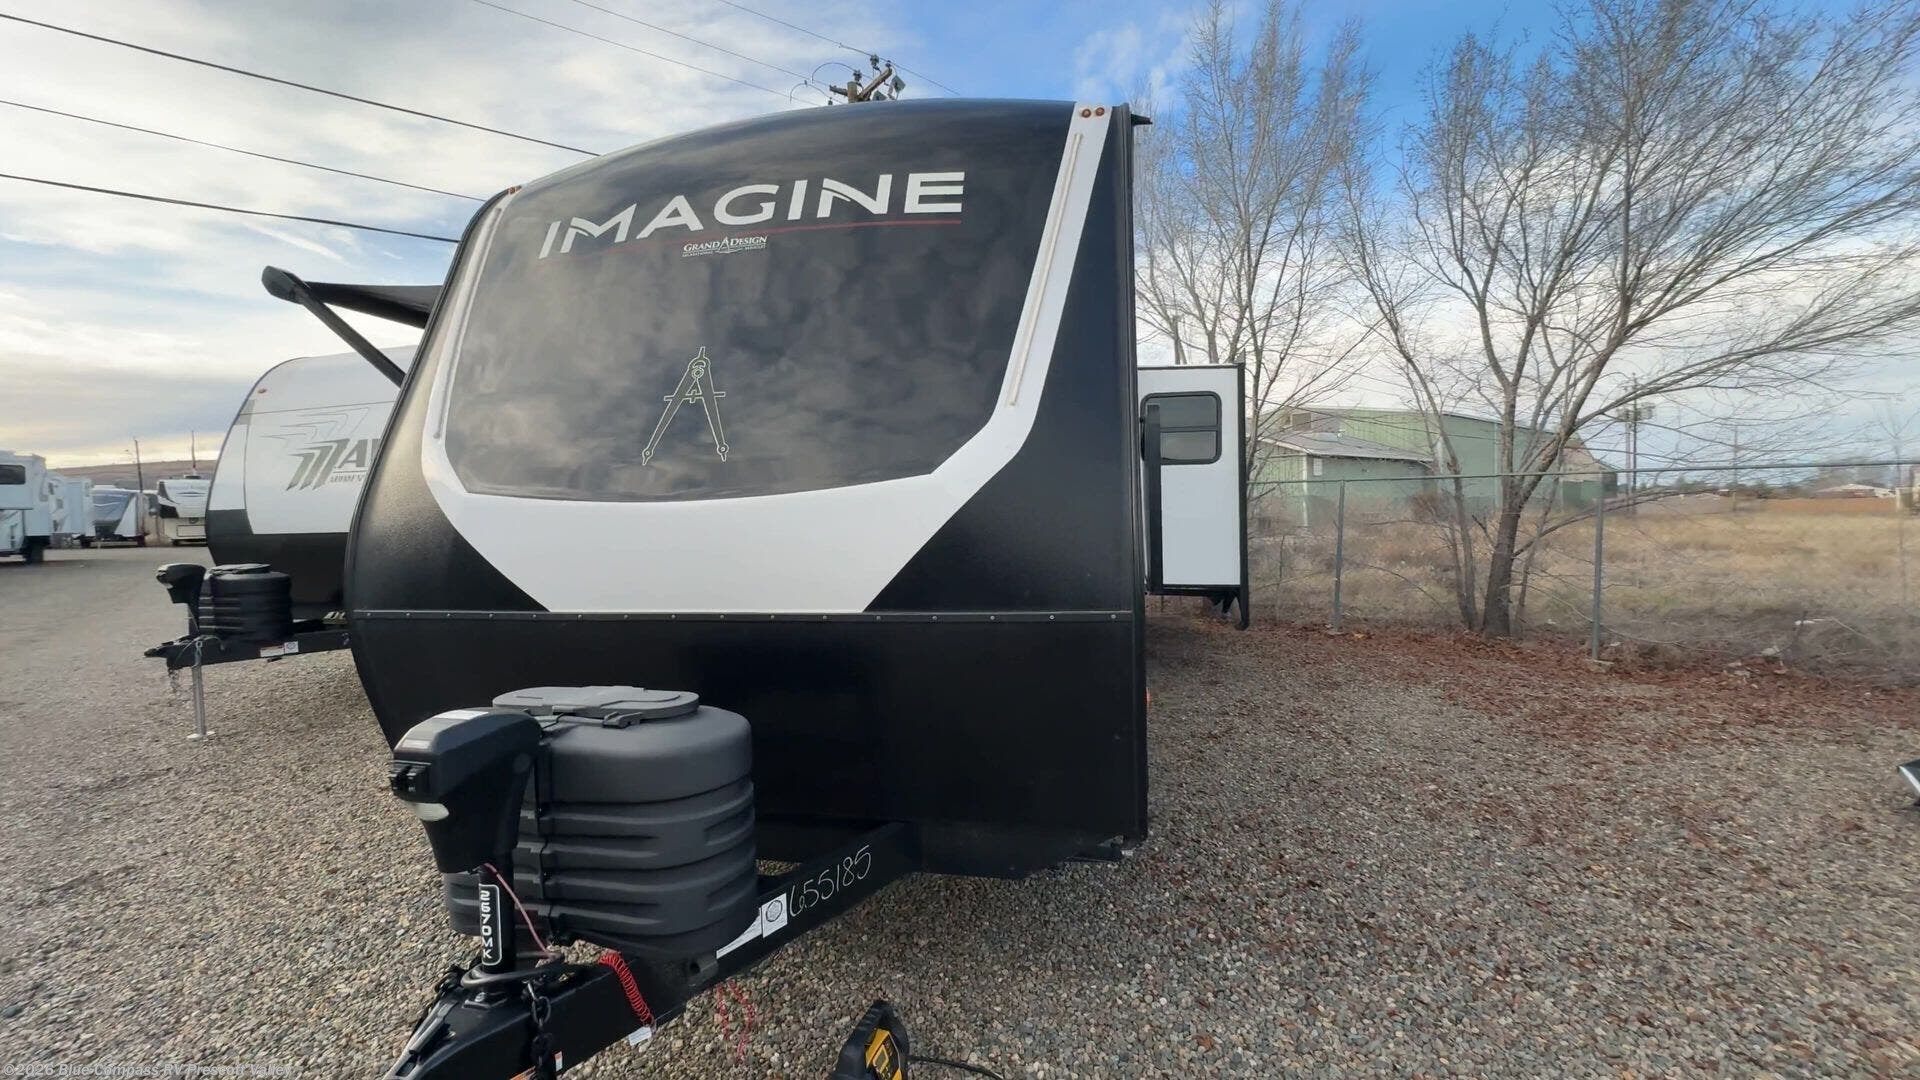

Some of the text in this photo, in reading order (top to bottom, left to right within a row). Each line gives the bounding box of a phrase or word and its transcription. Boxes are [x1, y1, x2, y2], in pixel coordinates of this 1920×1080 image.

[538, 171, 965, 259] IMAGINE
[789, 845, 872, 917] 655185
[480, 890, 494, 959] 2670MK
